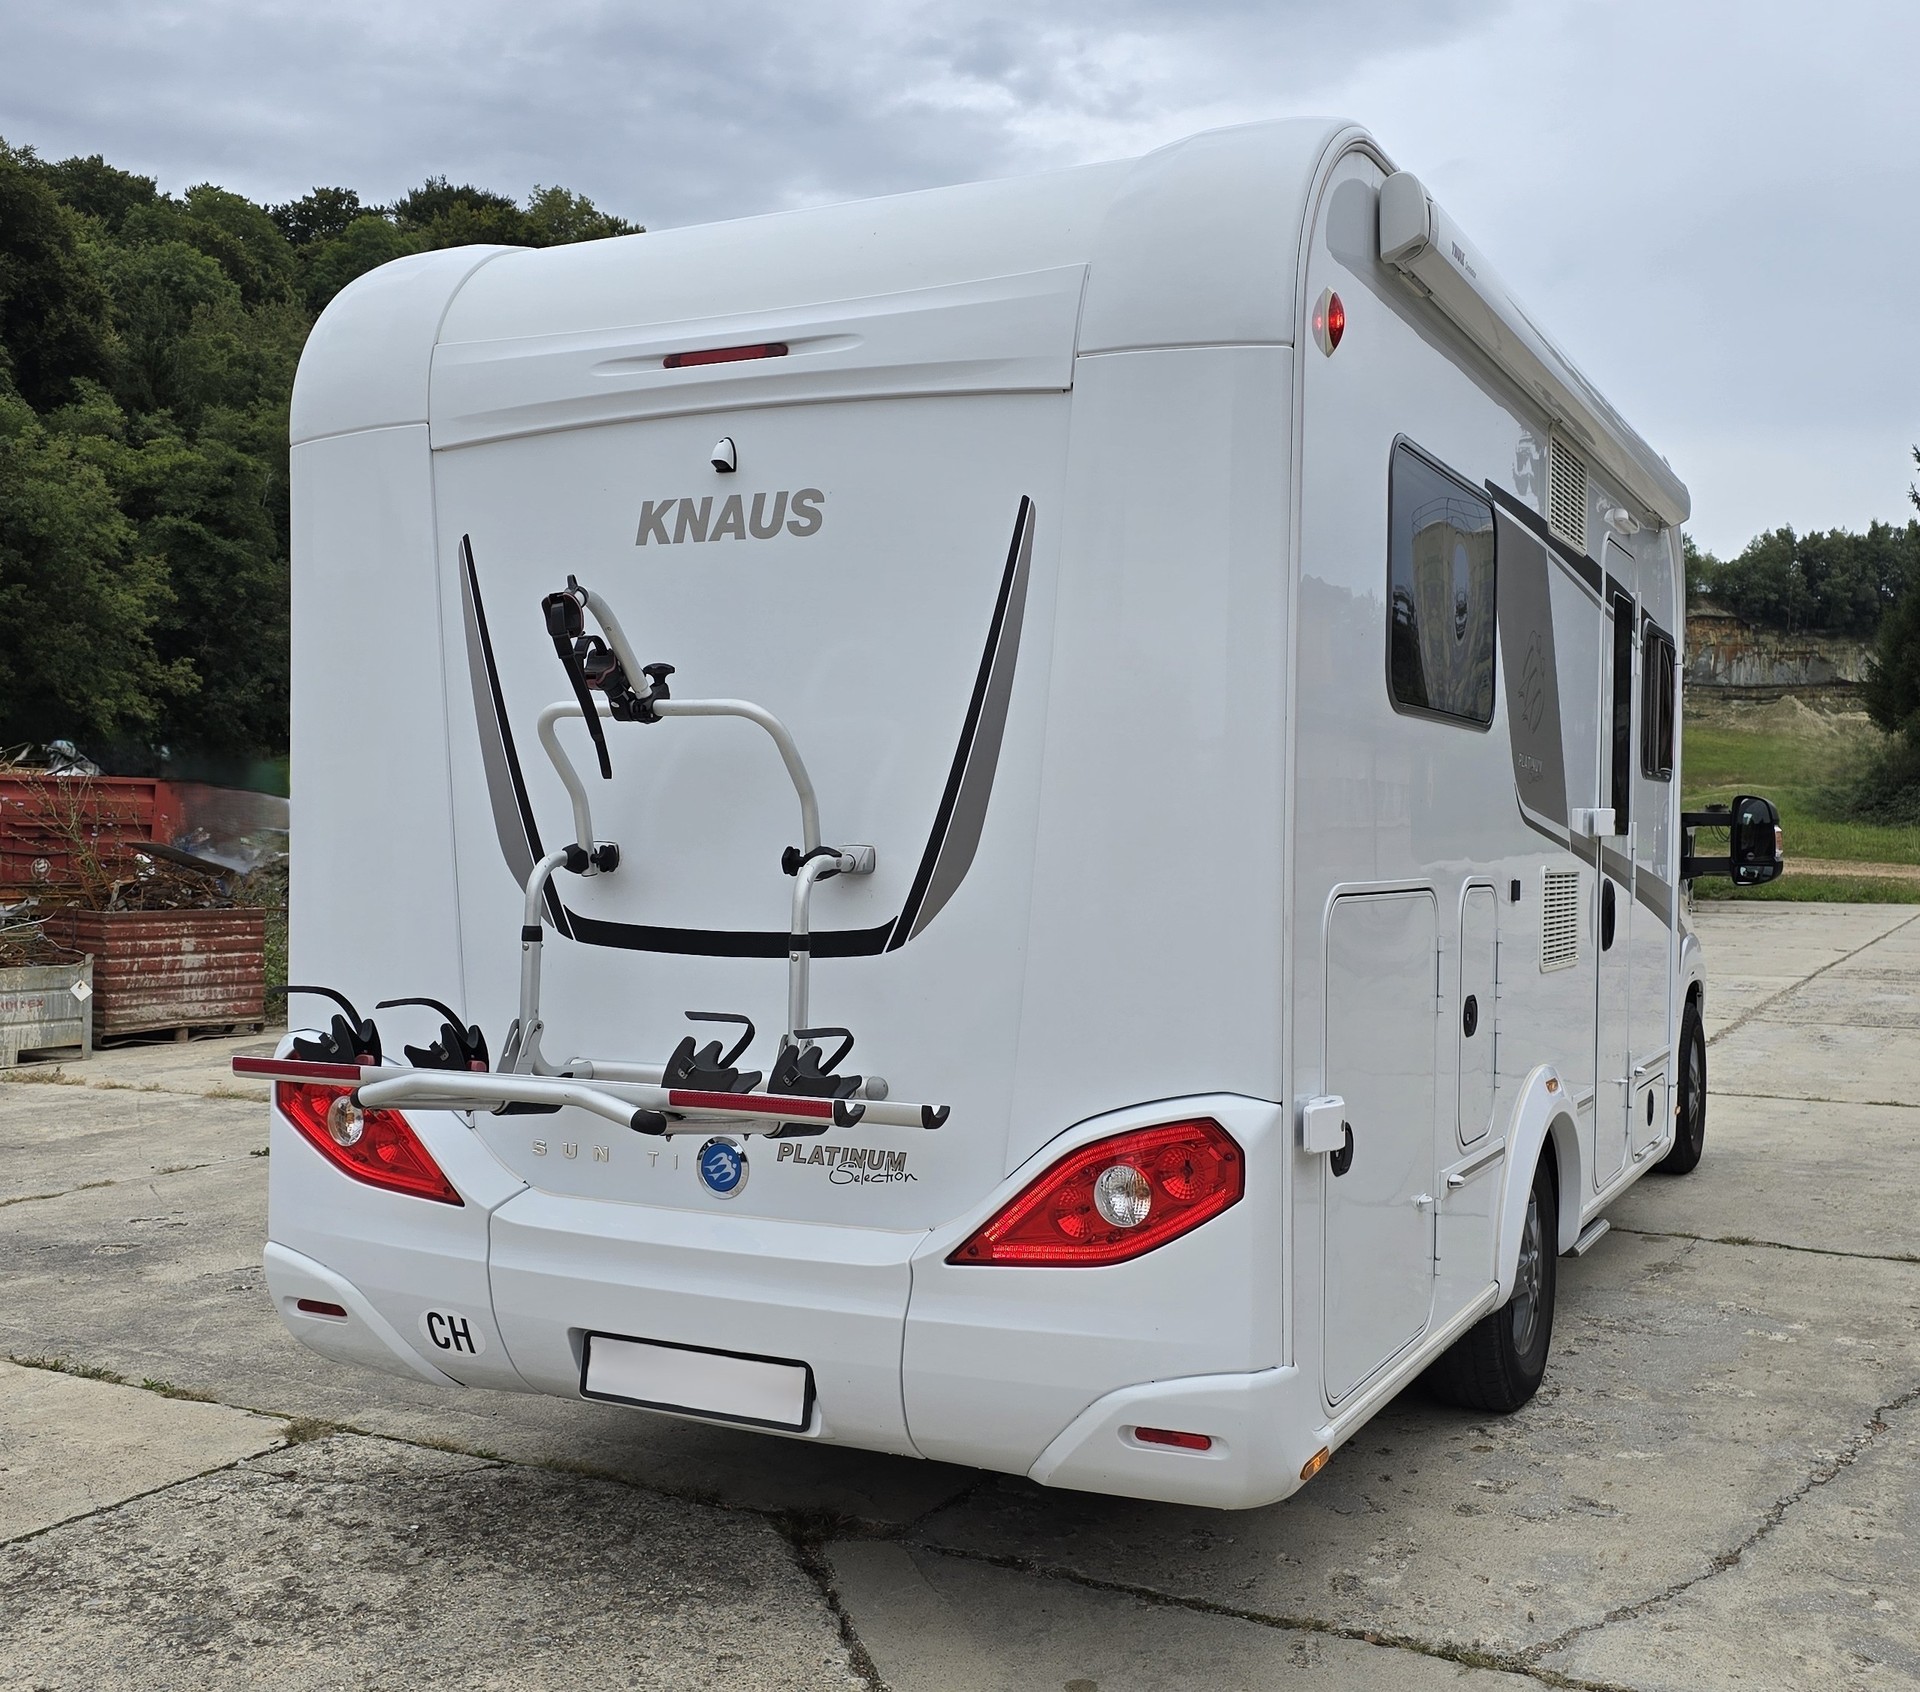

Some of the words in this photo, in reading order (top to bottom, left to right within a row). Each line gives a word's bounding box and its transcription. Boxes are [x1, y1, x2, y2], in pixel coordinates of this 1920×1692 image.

[635, 488, 825, 546] KNAUS
[532, 1139, 610, 1162] SUN
[777, 1142, 907, 1172] PLATINUM
[829, 1157, 918, 1185] Selection
[427, 1311, 476, 1354] CH
